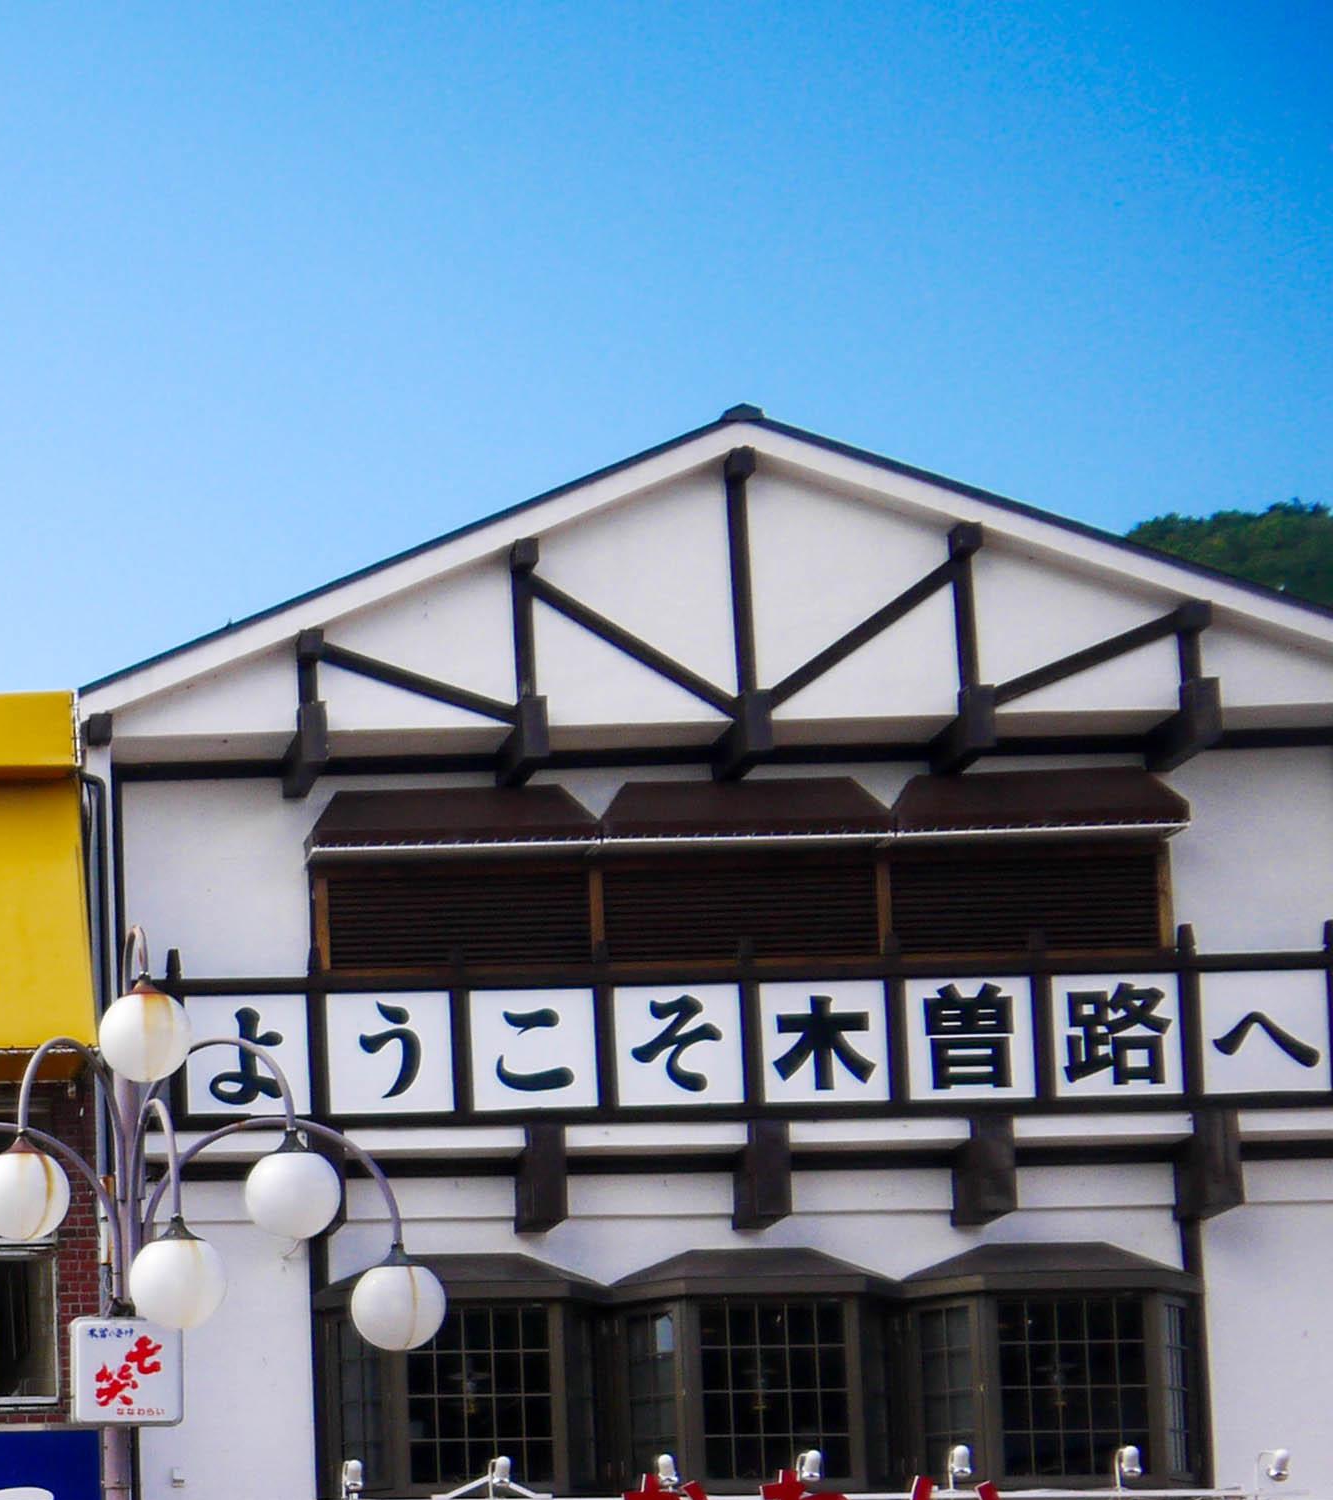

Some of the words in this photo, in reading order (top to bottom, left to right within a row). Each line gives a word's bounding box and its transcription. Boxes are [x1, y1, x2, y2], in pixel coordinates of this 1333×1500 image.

[211, 982, 1321, 1105] ようこそ木曽路へ
[94, 1335, 163, 1407] 七笑
[117, 1407, 165, 1416] ななわらい
